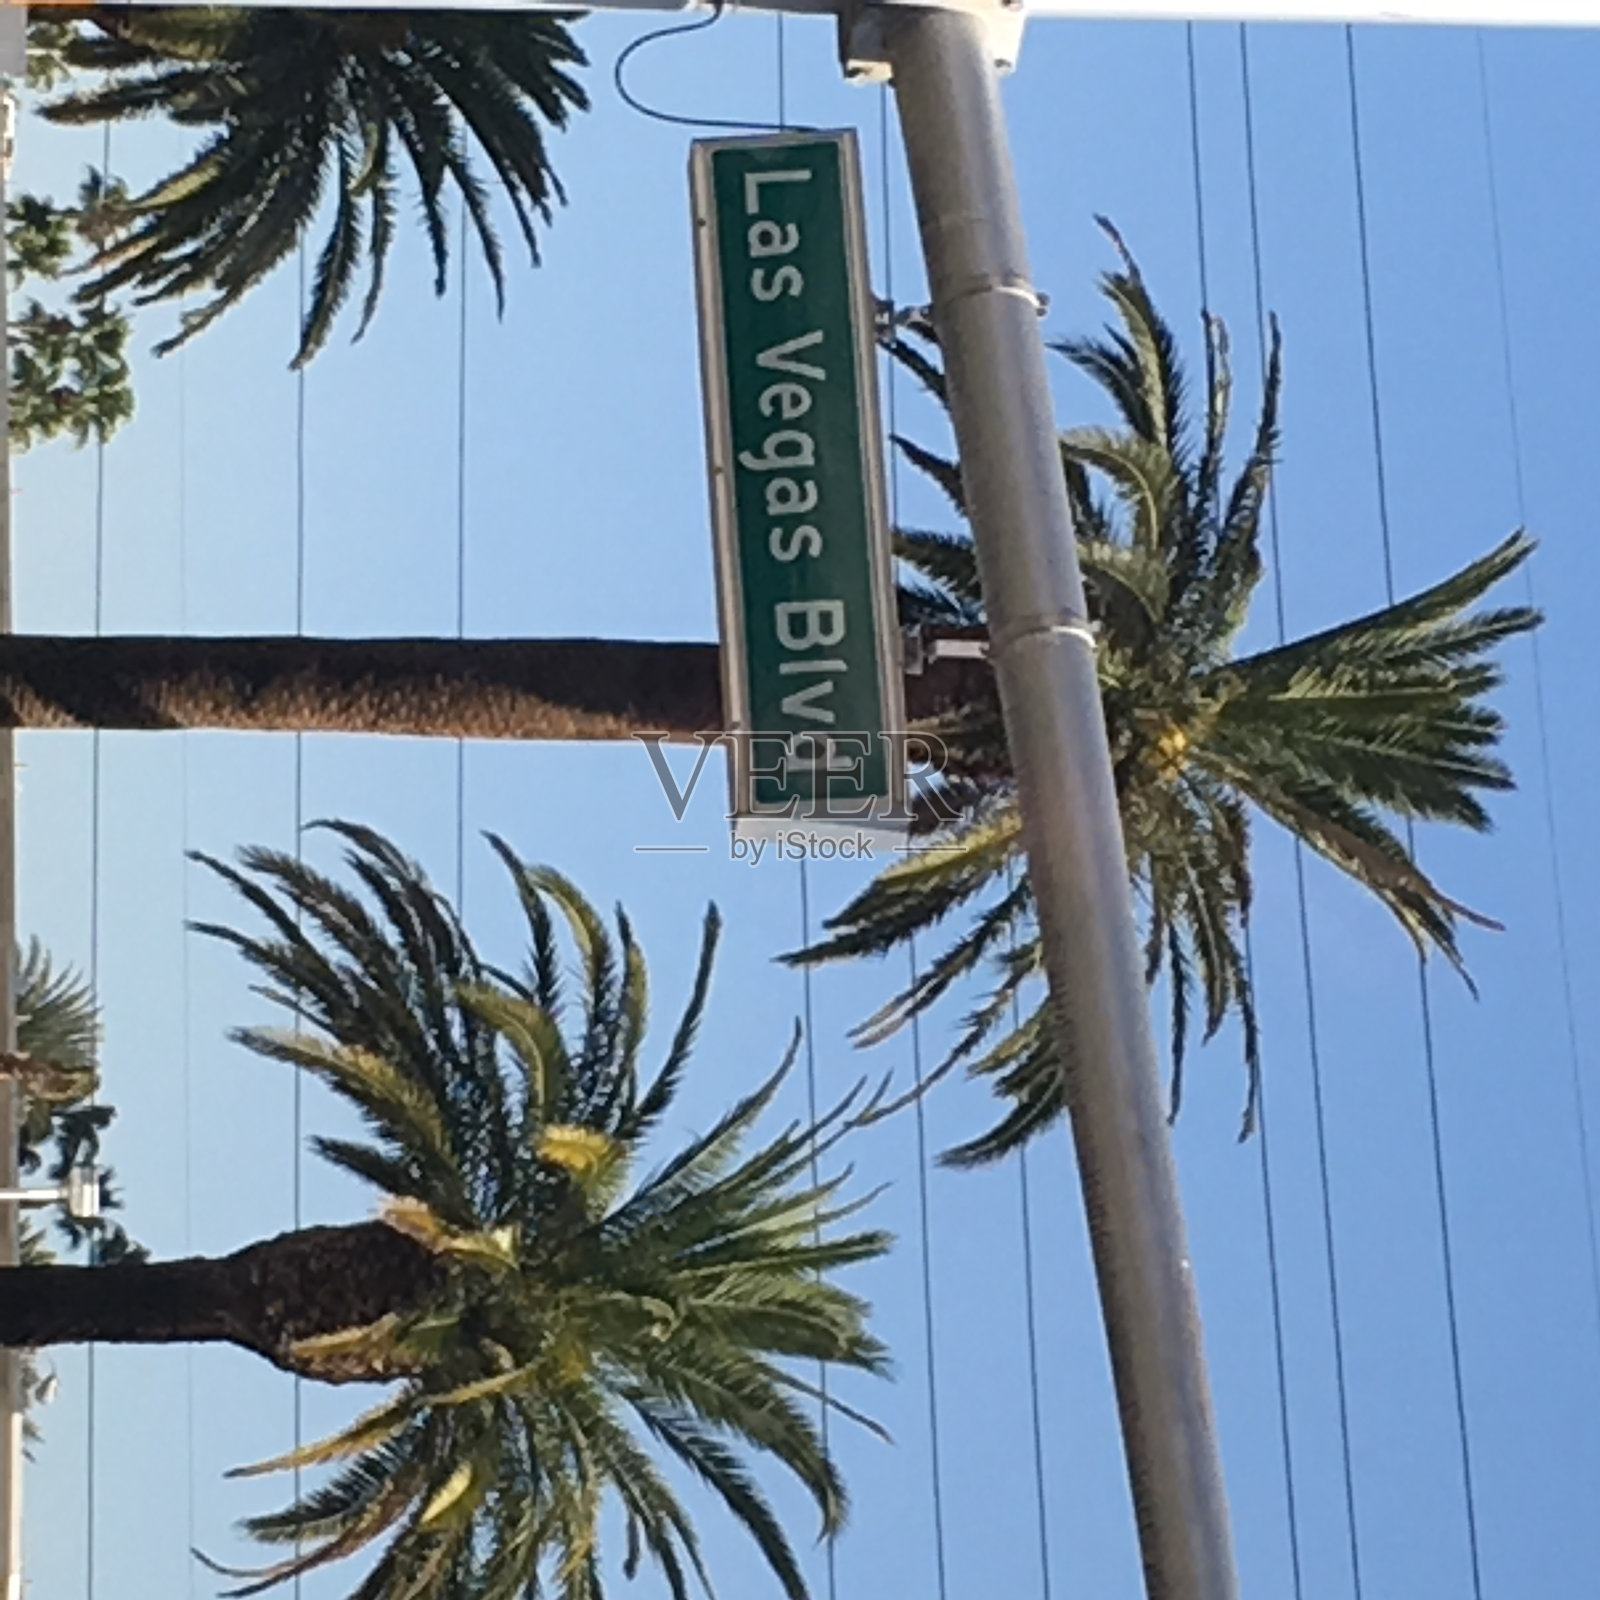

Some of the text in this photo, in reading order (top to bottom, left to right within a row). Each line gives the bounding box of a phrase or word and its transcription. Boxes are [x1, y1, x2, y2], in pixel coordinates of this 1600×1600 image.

[738, 168, 855, 772] Las Vegas Blvd
